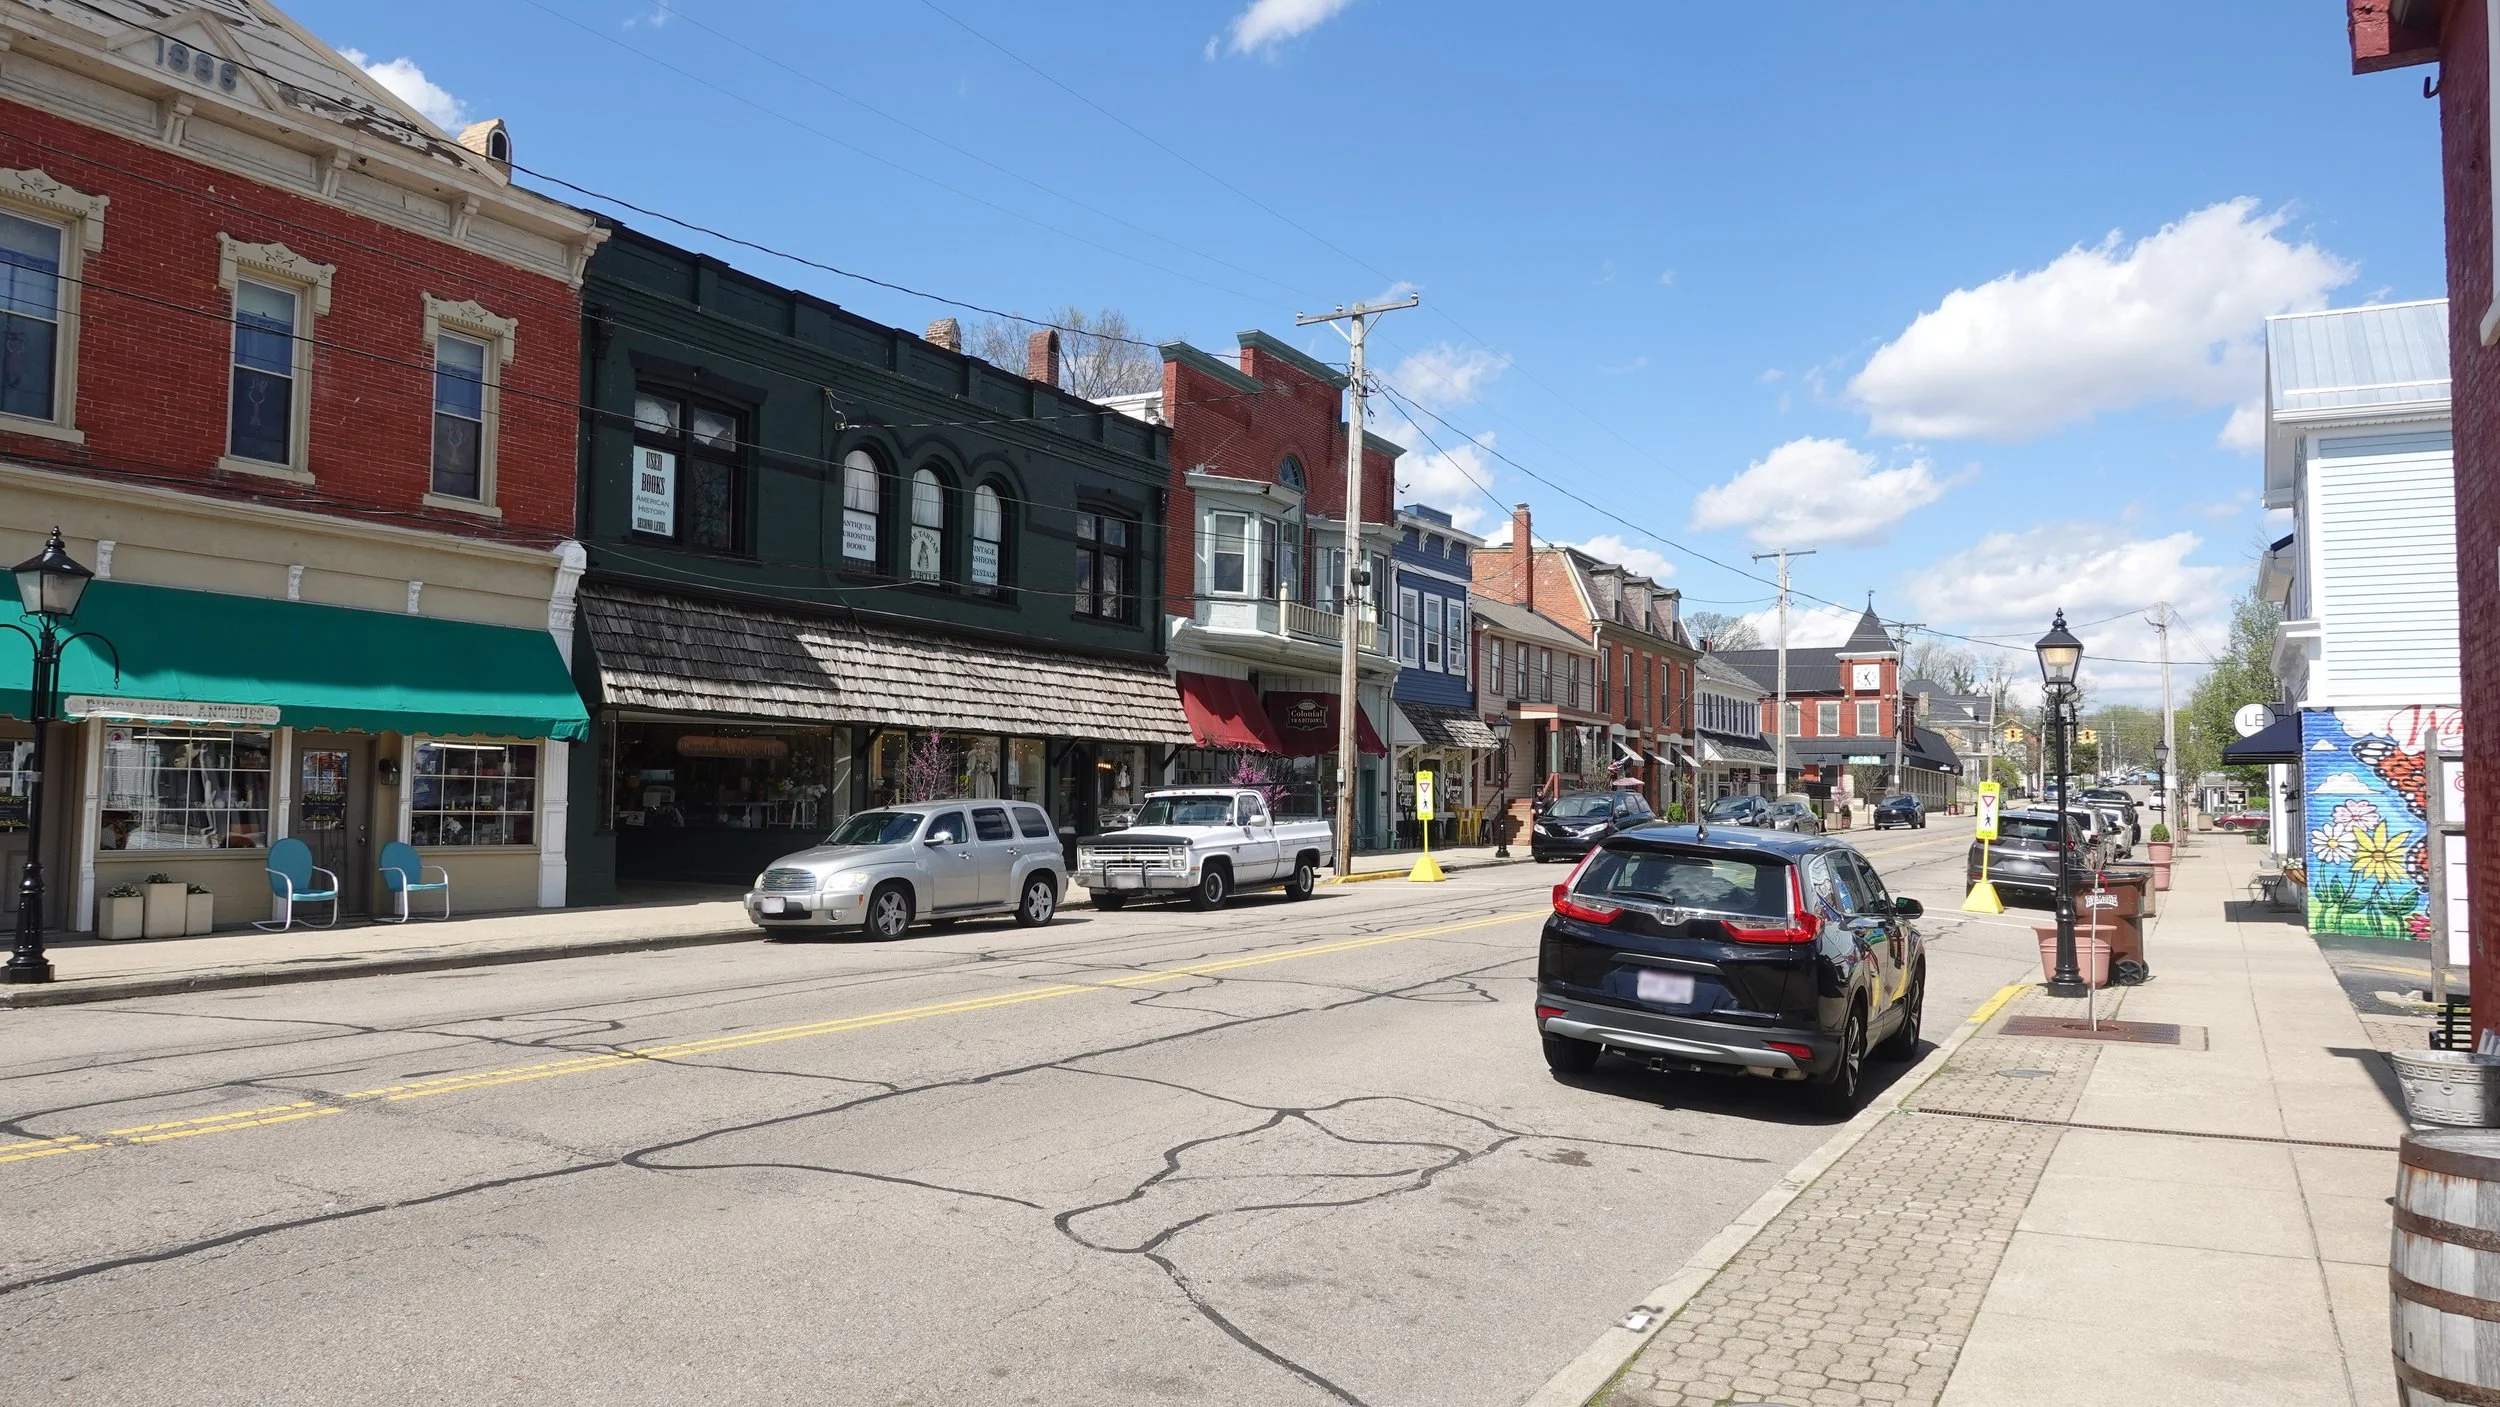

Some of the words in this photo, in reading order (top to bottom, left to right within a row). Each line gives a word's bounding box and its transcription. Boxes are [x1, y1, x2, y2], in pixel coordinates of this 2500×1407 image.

[646, 452, 663, 471] USED
[641, 473, 666, 495] BOOKS
[636, 494, 670, 508] AMERICAN
[638, 505, 666, 516] HISTORY
[843, 530, 875, 542] URIOSITIES
[846, 541, 867, 552] BOOKS
[918, 531, 939, 554] TARTAN
[973, 545, 995, 556] INTAGE
[973, 555, 997, 566] ASHIONS
[973, 567, 996, 579] RYSTALS
[198, 705, 265, 720] ANTIQUES
[1290, 709, 1323, 718] Colonial
